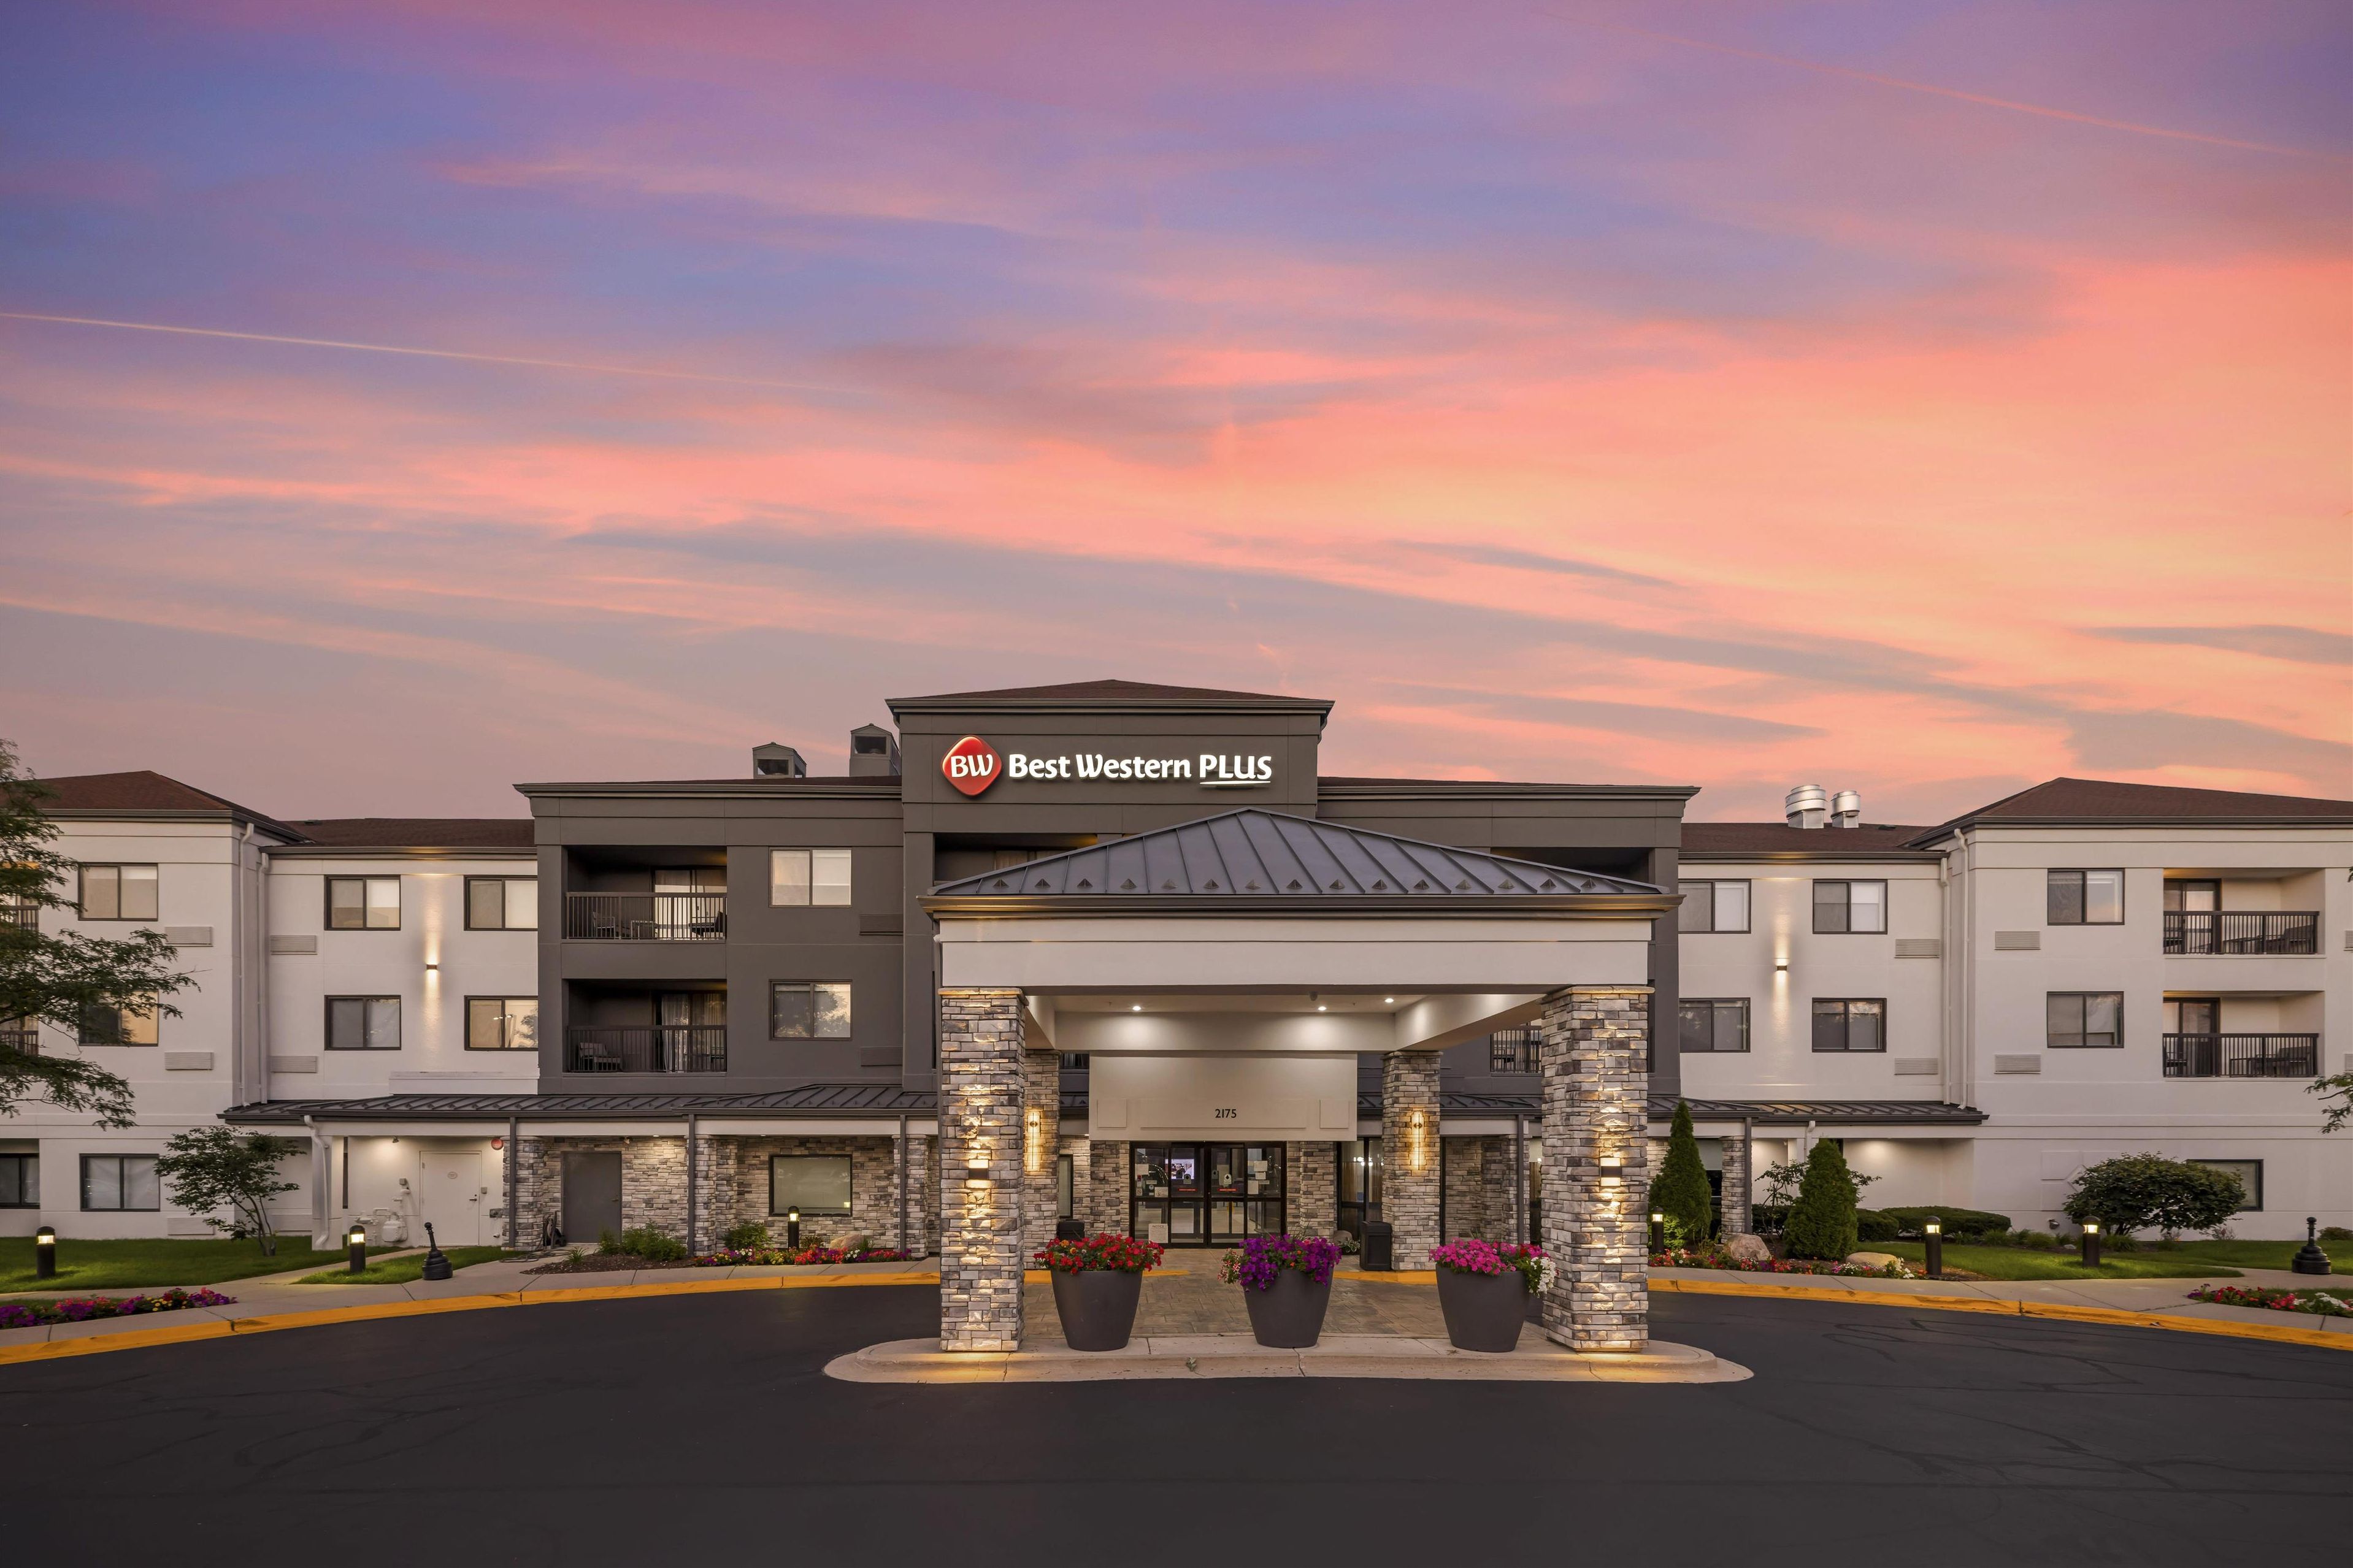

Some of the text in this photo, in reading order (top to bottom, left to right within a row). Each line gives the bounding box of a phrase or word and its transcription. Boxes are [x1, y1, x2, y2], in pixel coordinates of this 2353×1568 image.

[951, 754, 994, 778] BW
[1009, 754, 1272, 780] Best Western PLUS
[1215, 1108, 1237, 1119] 2175
